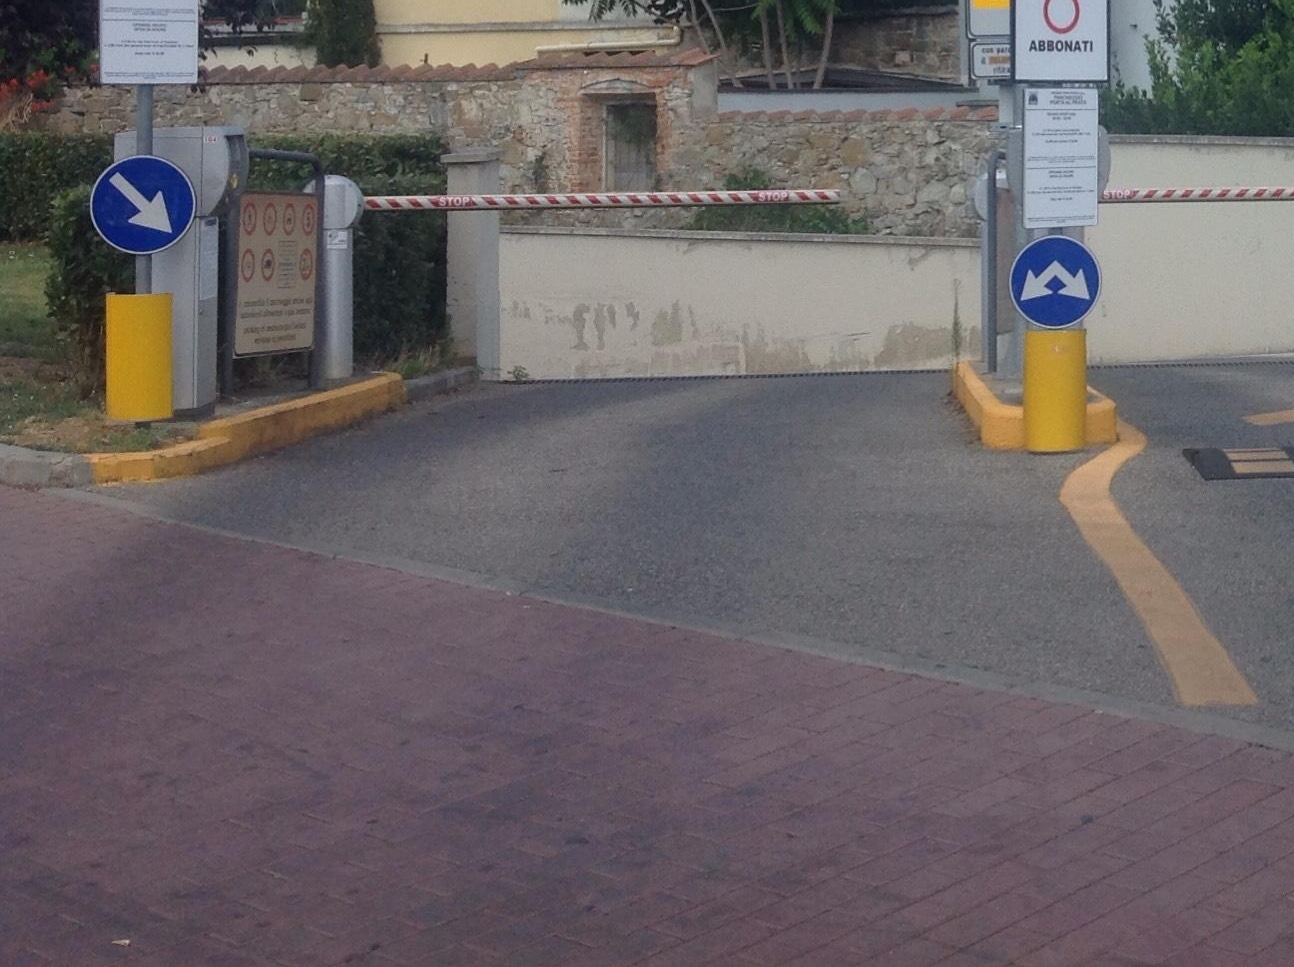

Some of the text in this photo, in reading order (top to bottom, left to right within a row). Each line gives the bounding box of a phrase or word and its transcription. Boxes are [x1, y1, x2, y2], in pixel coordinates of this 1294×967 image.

[1028, 40, 1094, 52] ABBONATI
[758, 192, 788, 202] STOP
[1103, 189, 1131, 199] STOP
[439, 195, 471, 206] STOP
